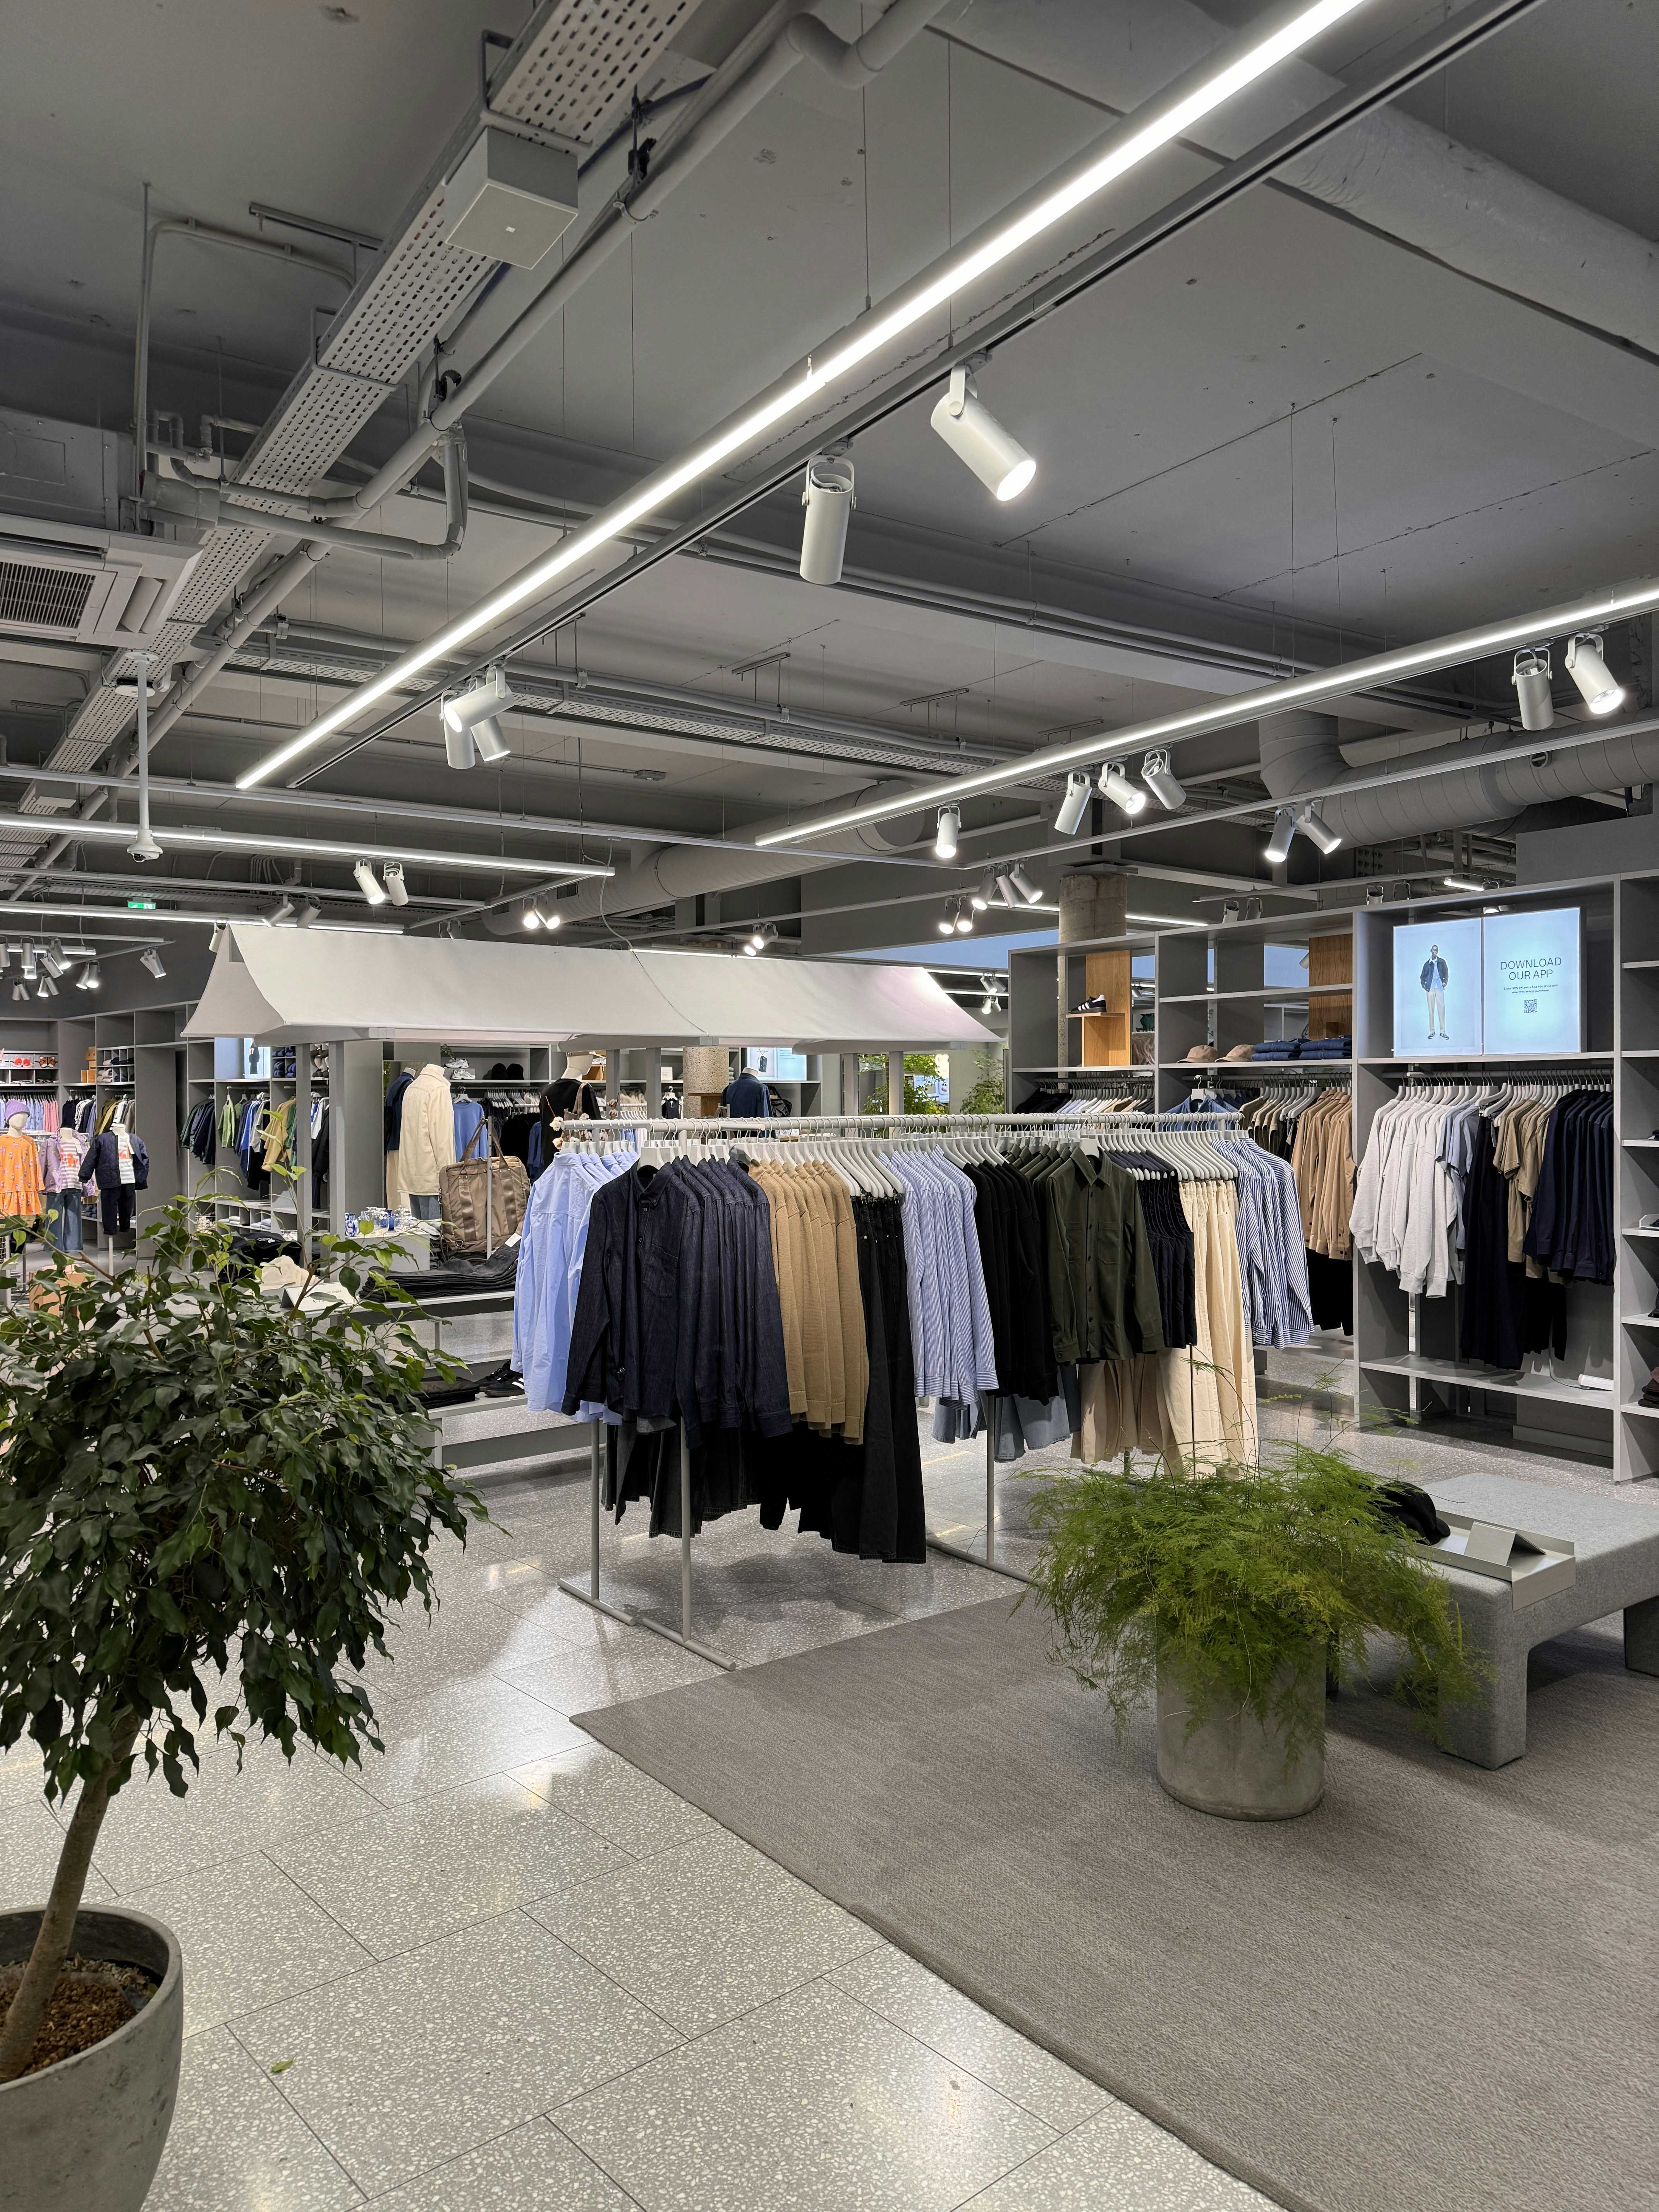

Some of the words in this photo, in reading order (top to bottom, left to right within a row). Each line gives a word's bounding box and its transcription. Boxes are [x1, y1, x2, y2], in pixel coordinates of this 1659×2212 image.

[1501, 957, 1561, 970] DOWNLOAD
[1509, 971, 1530, 980] OUR
[1533, 969, 1553, 979] APP
